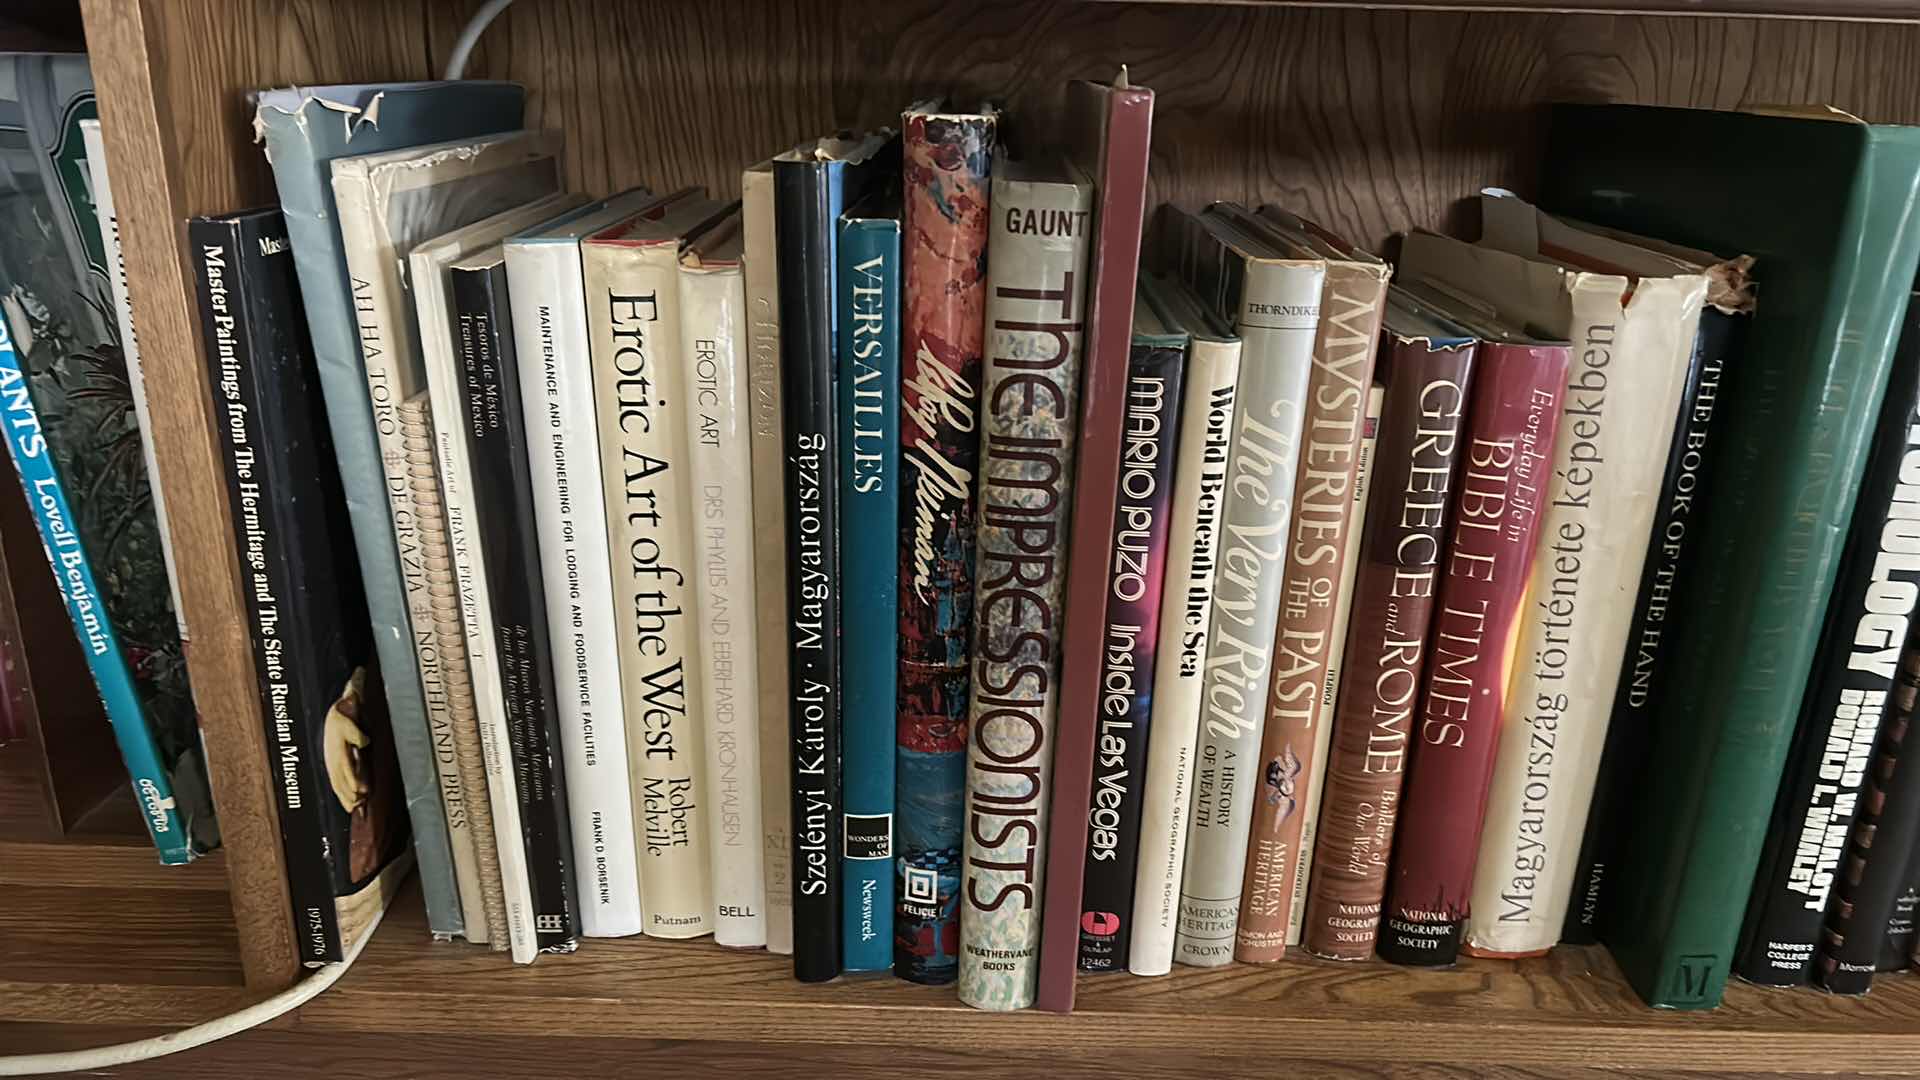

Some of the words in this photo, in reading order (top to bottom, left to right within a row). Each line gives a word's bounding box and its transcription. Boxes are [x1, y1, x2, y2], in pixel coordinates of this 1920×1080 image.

[1006, 207, 1089, 238] GAUNT
[203, 245, 227, 312] Master
[352, 276, 375, 314] AH
[214, 315, 240, 400] Paintings
[360, 324, 383, 360] HA
[460, 313, 477, 374] Treasures
[476, 312, 491, 364] Tesoros
[538, 305, 559, 398] MAINTENANCE
[609, 286, 666, 434] Erotic
[468, 374, 480, 390] of
[482, 364, 495, 380] de
[695, 339, 719, 407] EROTIC
[853, 254, 884, 493] VERSAILLES
[1692, 358, 1724, 424] THE
[227, 402, 249, 444] from
[369, 367, 397, 437] TORO
[471, 393, 484, 438] Mexico
[486, 382, 499, 429] México
[549, 402, 561, 428] AND
[1204, 384, 1234, 463] World
[1293, 289, 1376, 568] MYSTERIES
[1553, 321, 1616, 509] képekben
[699, 413, 720, 449] ART
[1233, 399, 1298, 507] The
[1514, 387, 1555, 484] Everyday
[235, 447, 259, 480] The
[552, 433, 571, 515] ENGINEERING
[622, 444, 670, 528] Art
[1388, 379, 1463, 600] GREECE
[1671, 430, 1707, 515] BOOK
[388, 475, 407, 508] DE
[703, 484, 725, 520] DRS
[1449, 436, 1515, 583] BIBLE
[1511, 483, 1538, 520] Life
[239, 482, 266, 571] Hermitage
[449, 505, 469, 559] FRANK
[562, 519, 574, 544] FOR
[789, 432, 829, 650] Magyarország
[903, 438, 974, 607] Neiman
[1190, 472, 1224, 580] Beneath
[1507, 525, 1528, 543] in
[1662, 519, 1686, 561] OF
[33, 476, 78, 555] Lovell
[59, 544, 108, 657] Benjamin
[394, 508, 425, 593] GRAZIA
[564, 547, 580, 600] LODGING
[629, 536, 684, 586] of
[705, 526, 728, 590] PHYLLIS
[1212, 499, 1290, 630] Very
[253, 573, 275, 603] and
[457, 564, 480, 640] FRAZETTA
[1184, 581, 1213, 625] the
[1284, 576, 1311, 621] THE
[1310, 576, 1334, 609] OF
[1536, 520, 1585, 683] története
[1647, 566, 1677, 622] THE
[259, 604, 280, 636] The
[500, 625, 514, 651] from
[515, 623, 527, 637] de
[571, 604, 584, 630] AND
[634, 589, 683, 657] the
[713, 595, 730, 637] AND
[1383, 600, 1407, 637] and
[263, 638, 283, 681] State
[504, 653, 516, 670] the
[517, 638, 529, 654] los
[574, 632, 593, 708] FOODSERVICE
[1105, 623, 1142, 716] Inside
[1180, 628, 1206, 679] Sea
[1629, 629, 1661, 708] HAND
[416, 631, 453, 765] NORTHLAND
[506, 672, 521, 714] Mexican
[518, 657, 534, 694] Museos
[714, 639, 735, 725] EBERHARD
[1206, 623, 1269, 740] Rich
[1271, 628, 1326, 729] PAST
[1323, 668, 1335, 706] POMPEII
[1422, 599, 1489, 749] TIMES
[270, 683, 293, 743] Russian
[523, 697, 539, 748] Nacionales
[640, 656, 687, 761] West
[797, 677, 831, 776] Károly
[1362, 635, 1422, 774] ROME
[510, 718, 526, 758] National
[582, 711, 598, 768] FACILITIES
[1099, 718, 1126, 768] Las
[1204, 744, 1218, 767] OF
[1224, 750, 1237, 761] A
[1818, 687, 1867, 781] DONALD
[1839, 688, 1888, 788] RICHARD
[279, 745, 302, 809] Museum
[442, 773, 467, 830] PRESS
[517, 760, 532, 805] Museums
[529, 751, 546, 801] Mexicanos
[715, 730, 742, 847] KRONHAUSEN
[1175, 747, 1187, 803] NATIONAL
[1196, 768, 1215, 830] WEALTH
[1216, 765, 1237, 829] HISTORY
[1810, 783, 1839, 805] L.
[642, 776, 670, 857] Melville
[667, 776, 692, 847] Robert
[1087, 768, 1129, 862] Vegas
[1356, 801, 1376, 834] Our
[1377, 789, 1398, 853] Builders
[1499, 692, 1569, 924] Magyarország
[1829, 791, 1858, 823] W.
[592, 811, 604, 842] FRANK
[598, 855, 610, 905] BORSENIK
[800, 789, 832, 896] Szelényi
[847, 834, 890, 844] WONDERS
[868, 850, 890, 858] MAN
[877, 842, 890, 850] OF
[1167, 805, 1182, 879] GEOGRAPHIC
[1349, 834, 1371, 877] World
[1376, 851, 1387, 868] of
[1786, 805, 1832, 895] WHALEY
[1249, 838, 1273, 917] HERITAGE
[1267, 840, 1289, 919] AMERICAN
[1582, 862, 1605, 926] HAMLYN
[1804, 823, 1849, 914] MALOTT
[654, 914, 702, 926] Putnam
[719, 906, 755, 918] BELL
[861, 879, 878, 942] Newsweek
[903, 903, 937, 918] FELICIE
[1160, 878, 1173, 929] SOCIETY
[1389, 919, 1454, 936] GEOGRAPHIC
[1400, 907, 1448, 921] NATIONAL
[304, 906, 326, 956] 1975-1976
[1182, 943, 1231, 957] CROWN
[1336, 931, 1374, 942] SOCIETY
[1397, 935, 1440, 950] SOCIETY
[1767, 950, 1810, 962] COLLEGE
[1768, 940, 1815, 952] HARPER'S
[983, 961, 1016, 972] BOOKS
[1081, 956, 1112, 967] 12462
[1771, 960, 1803, 970] PRESS
